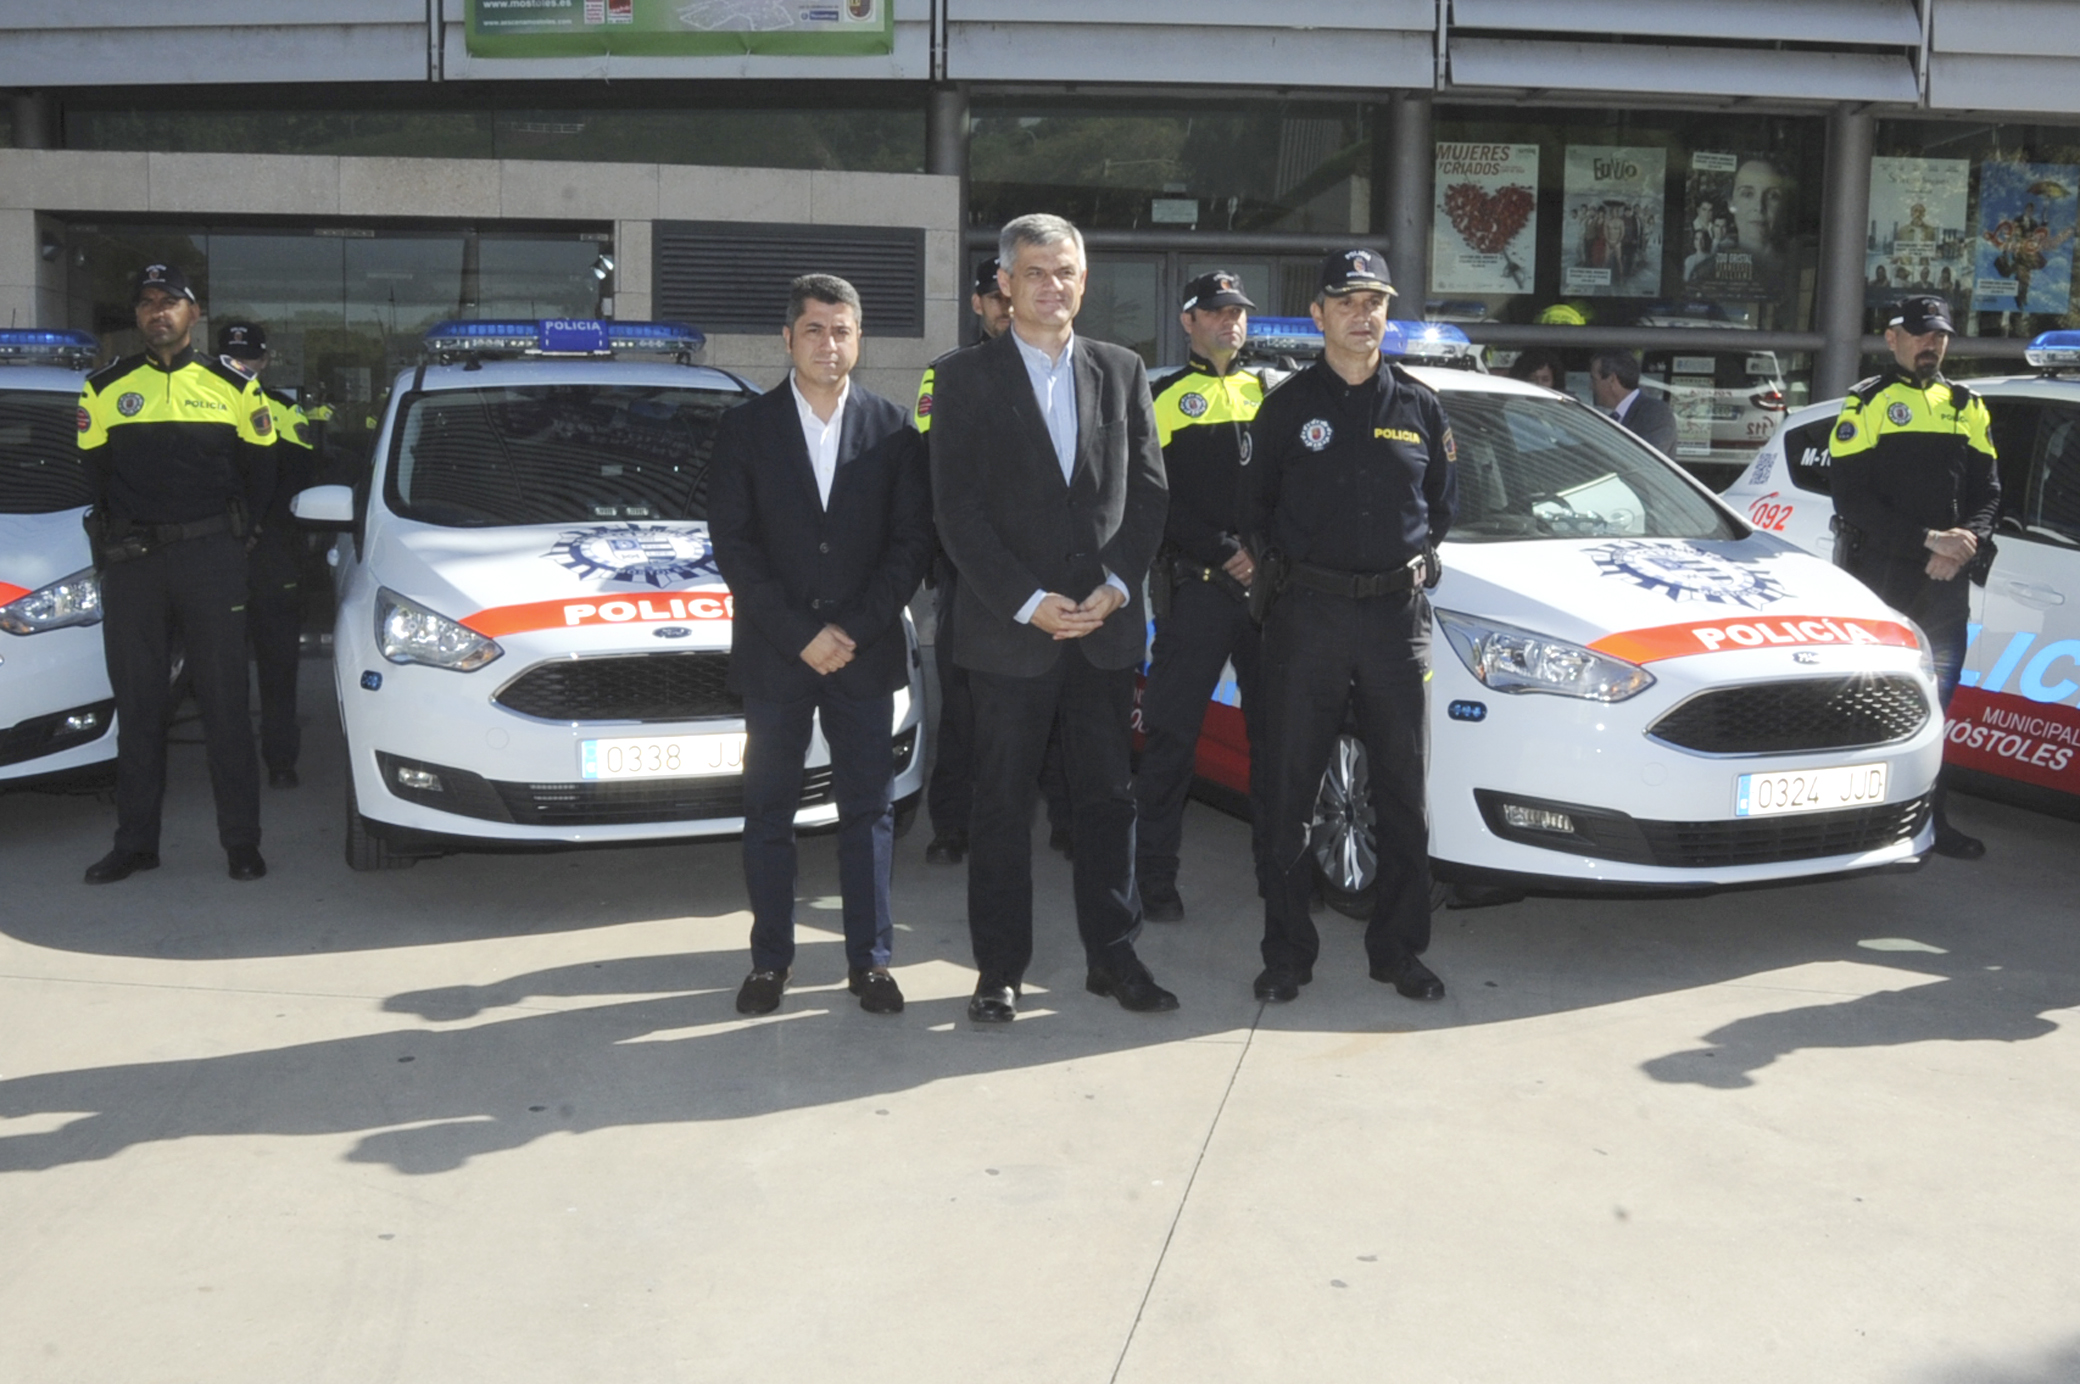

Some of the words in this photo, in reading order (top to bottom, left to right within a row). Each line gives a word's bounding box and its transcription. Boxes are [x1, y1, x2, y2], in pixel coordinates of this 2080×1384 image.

[1436, 144, 1511, 161] MUJERES
[1443, 161, 1501, 176] CRIADOS
[1374, 427, 1421, 444] POLICIA
[1800, 447, 1831, 467] M-1
[1751, 502, 1794, 531] 092
[1692, 619, 1880, 651] POLICÍA
[1982, 706, 2080, 747] MUNICIPAL
[607, 744, 682, 773] 0338
[708, 740, 743, 768] JJ
[1758, 776, 1820, 809] 0324
[1839, 769, 1881, 802] JJD
